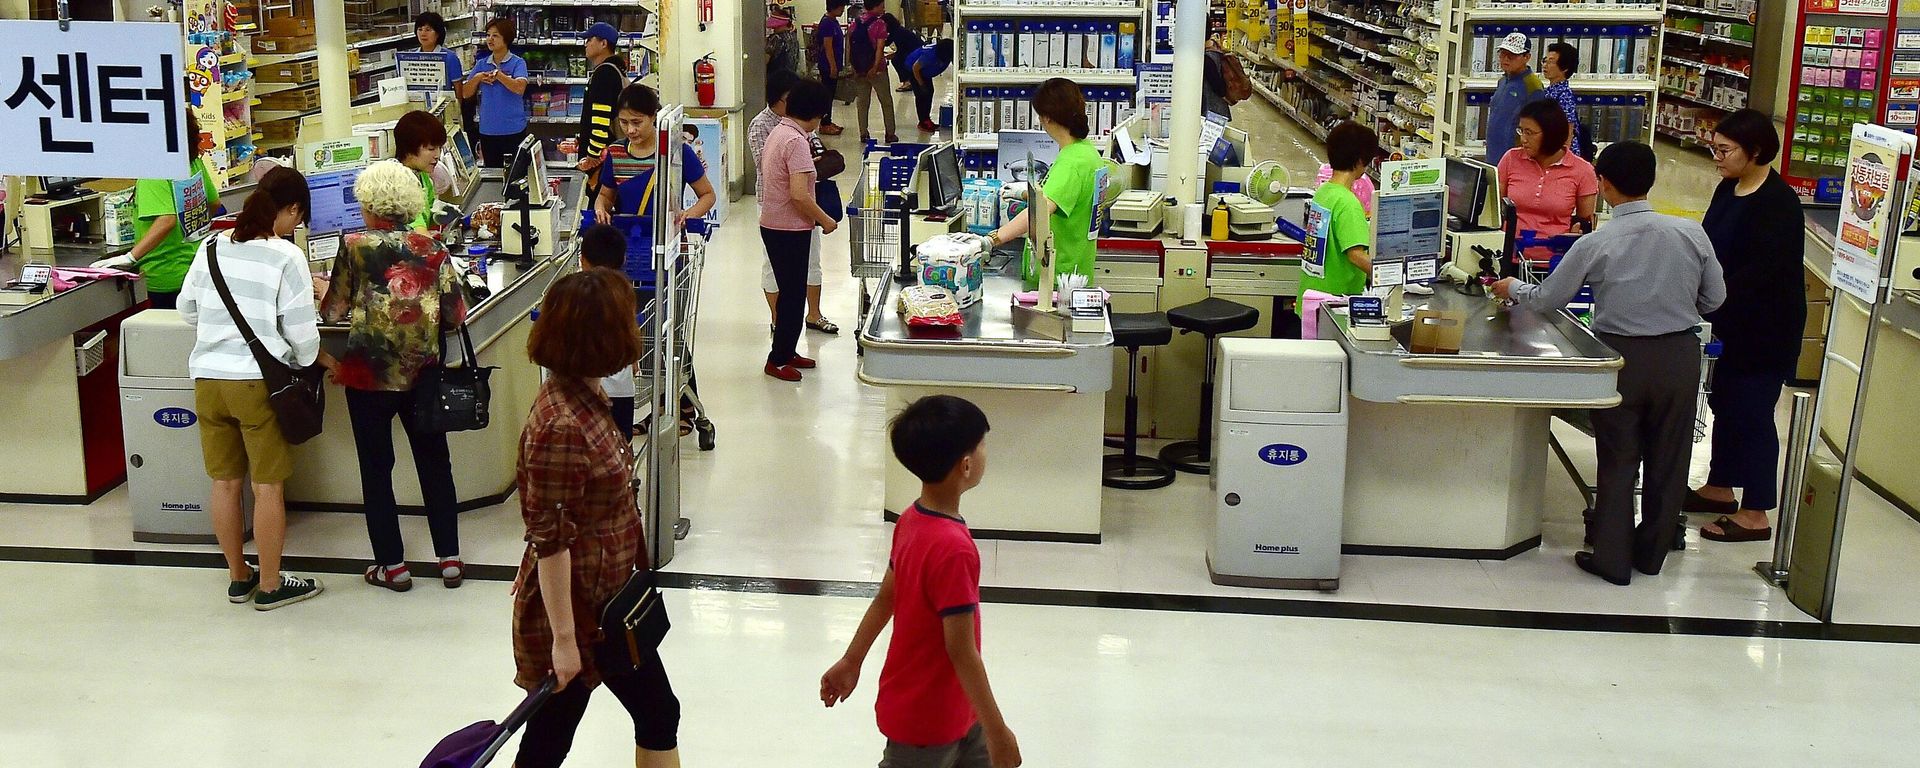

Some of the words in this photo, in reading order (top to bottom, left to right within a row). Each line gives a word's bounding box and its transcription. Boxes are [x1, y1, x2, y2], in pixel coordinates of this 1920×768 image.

[1249, 8, 1260, 18] 20
[1278, 21, 1289, 32] 30
[1295, 27, 1308, 38] 30
[4, 52, 180, 154] 센터
[201, 112, 216, 120] Kids
[1851, 165, 1890, 191] 자동차보험
[162, 412, 190, 425] 휴지통
[1268, 449, 1299, 462] 휴지통
[1255, 543, 1280, 552] Home
[1281, 544, 1299, 553] plus
